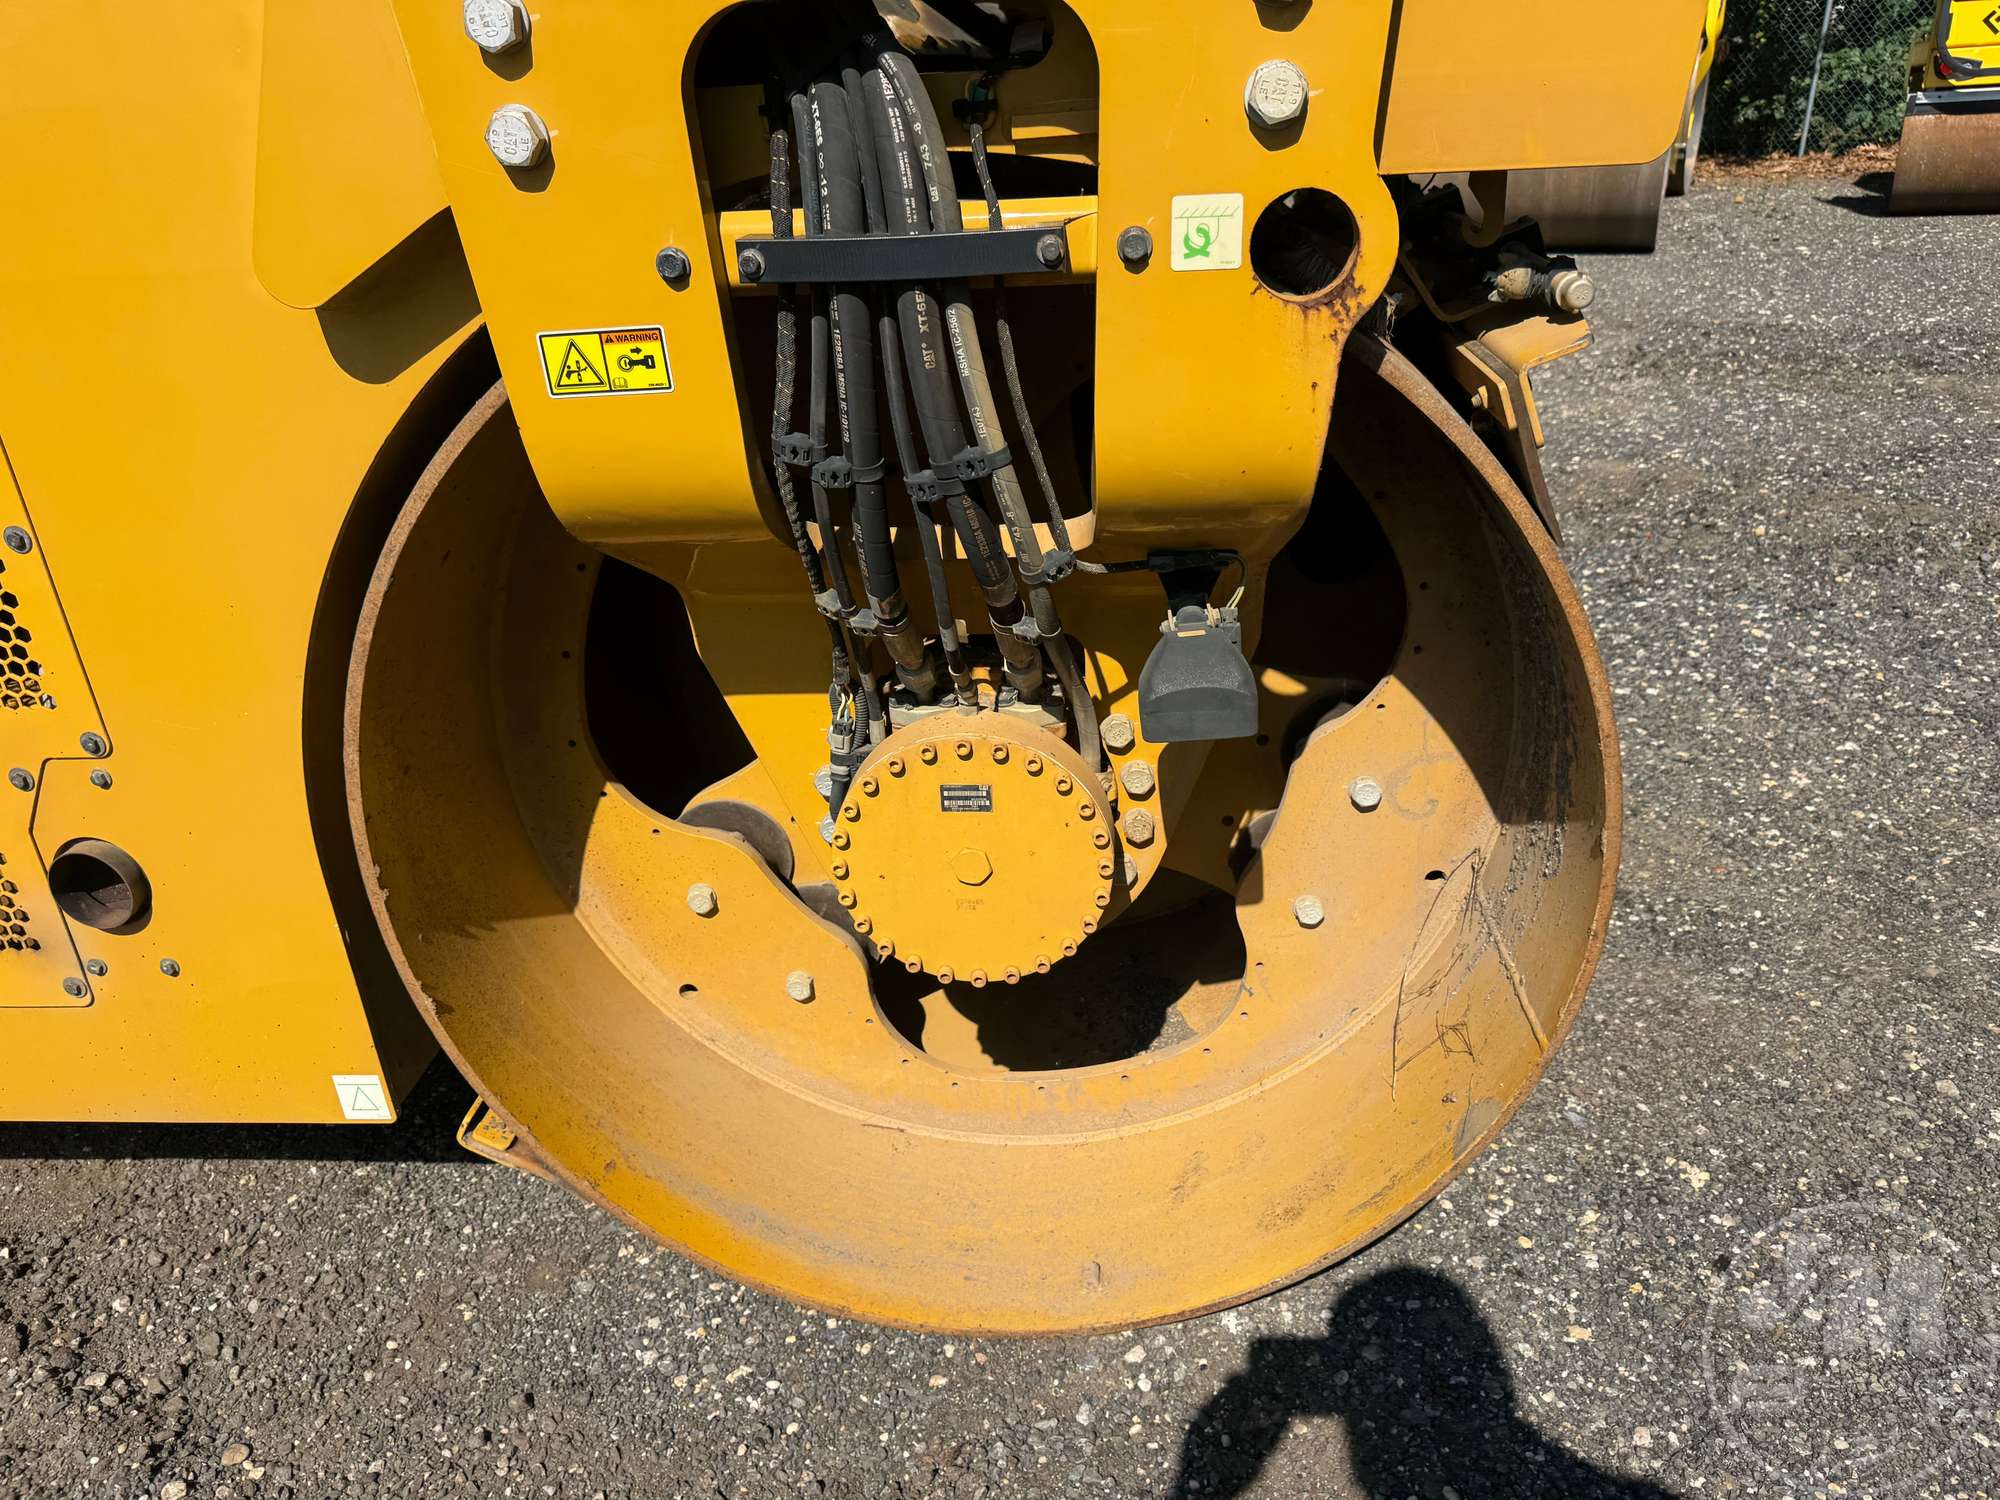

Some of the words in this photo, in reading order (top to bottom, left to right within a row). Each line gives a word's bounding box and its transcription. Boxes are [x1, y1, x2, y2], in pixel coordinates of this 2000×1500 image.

[920, 143, 932, 171] 743
[931, 184, 940, 202] CAT
[615, 332, 659, 343] WARNING
[957, 348, 970, 377] MSHA
[837, 372, 846, 399] MSHA
[1011, 526, 1023, 543] 743
